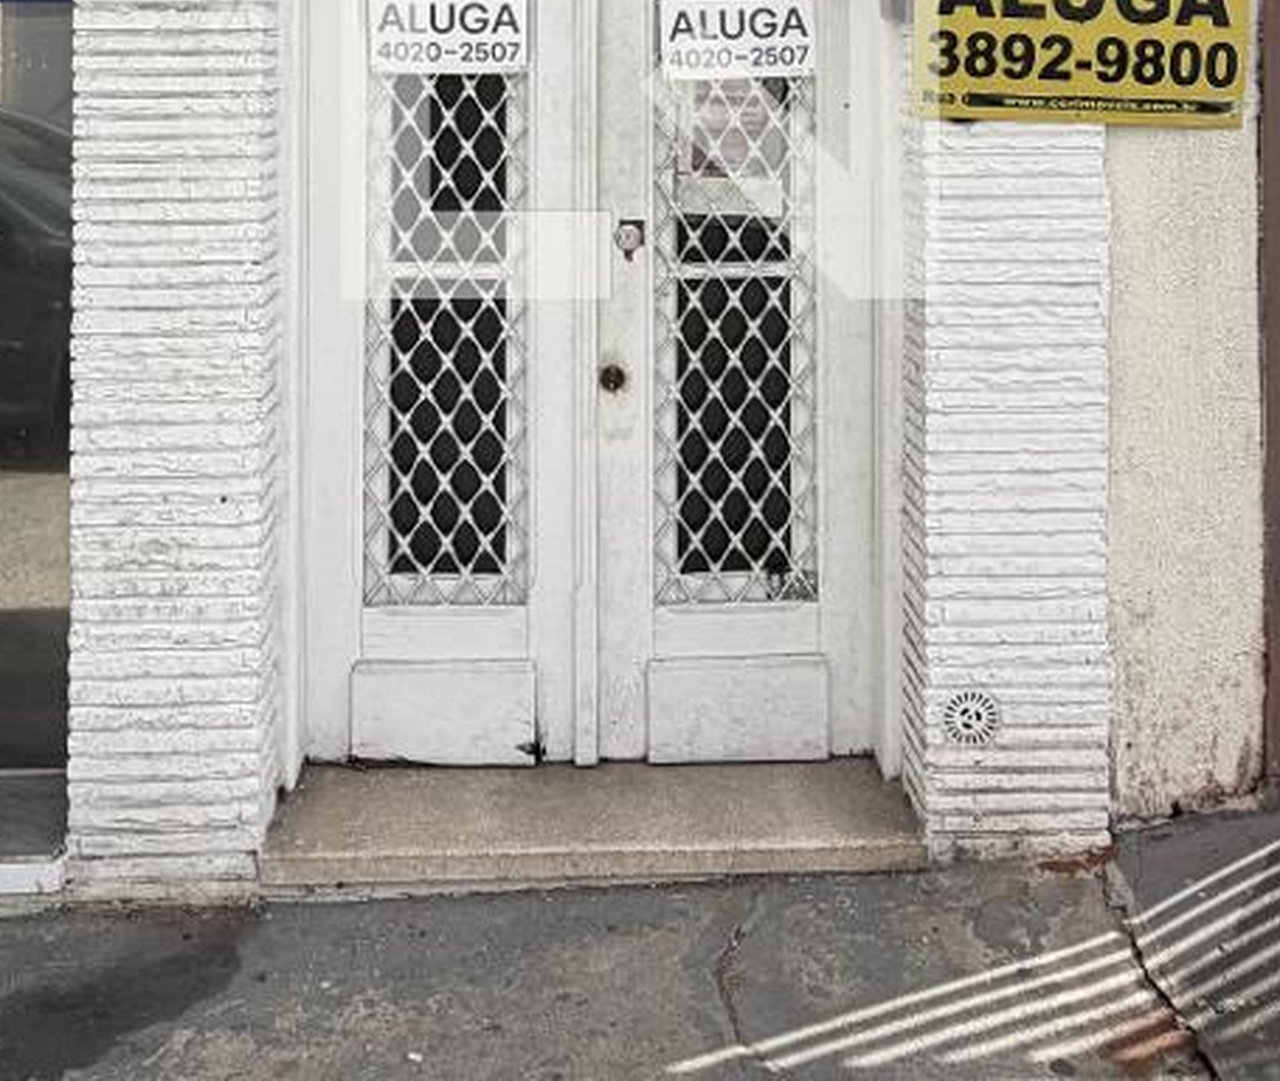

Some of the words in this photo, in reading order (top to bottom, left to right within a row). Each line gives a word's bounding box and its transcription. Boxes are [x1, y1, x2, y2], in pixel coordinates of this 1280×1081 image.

[378, 2, 520, 35] ALUGA
[669, 6, 809, 42] ALUGA
[377, 41, 521, 63] 4020-2507
[669, 45, 810, 69] 4020-2507
[928, 29, 1239, 89] 3892-9800
